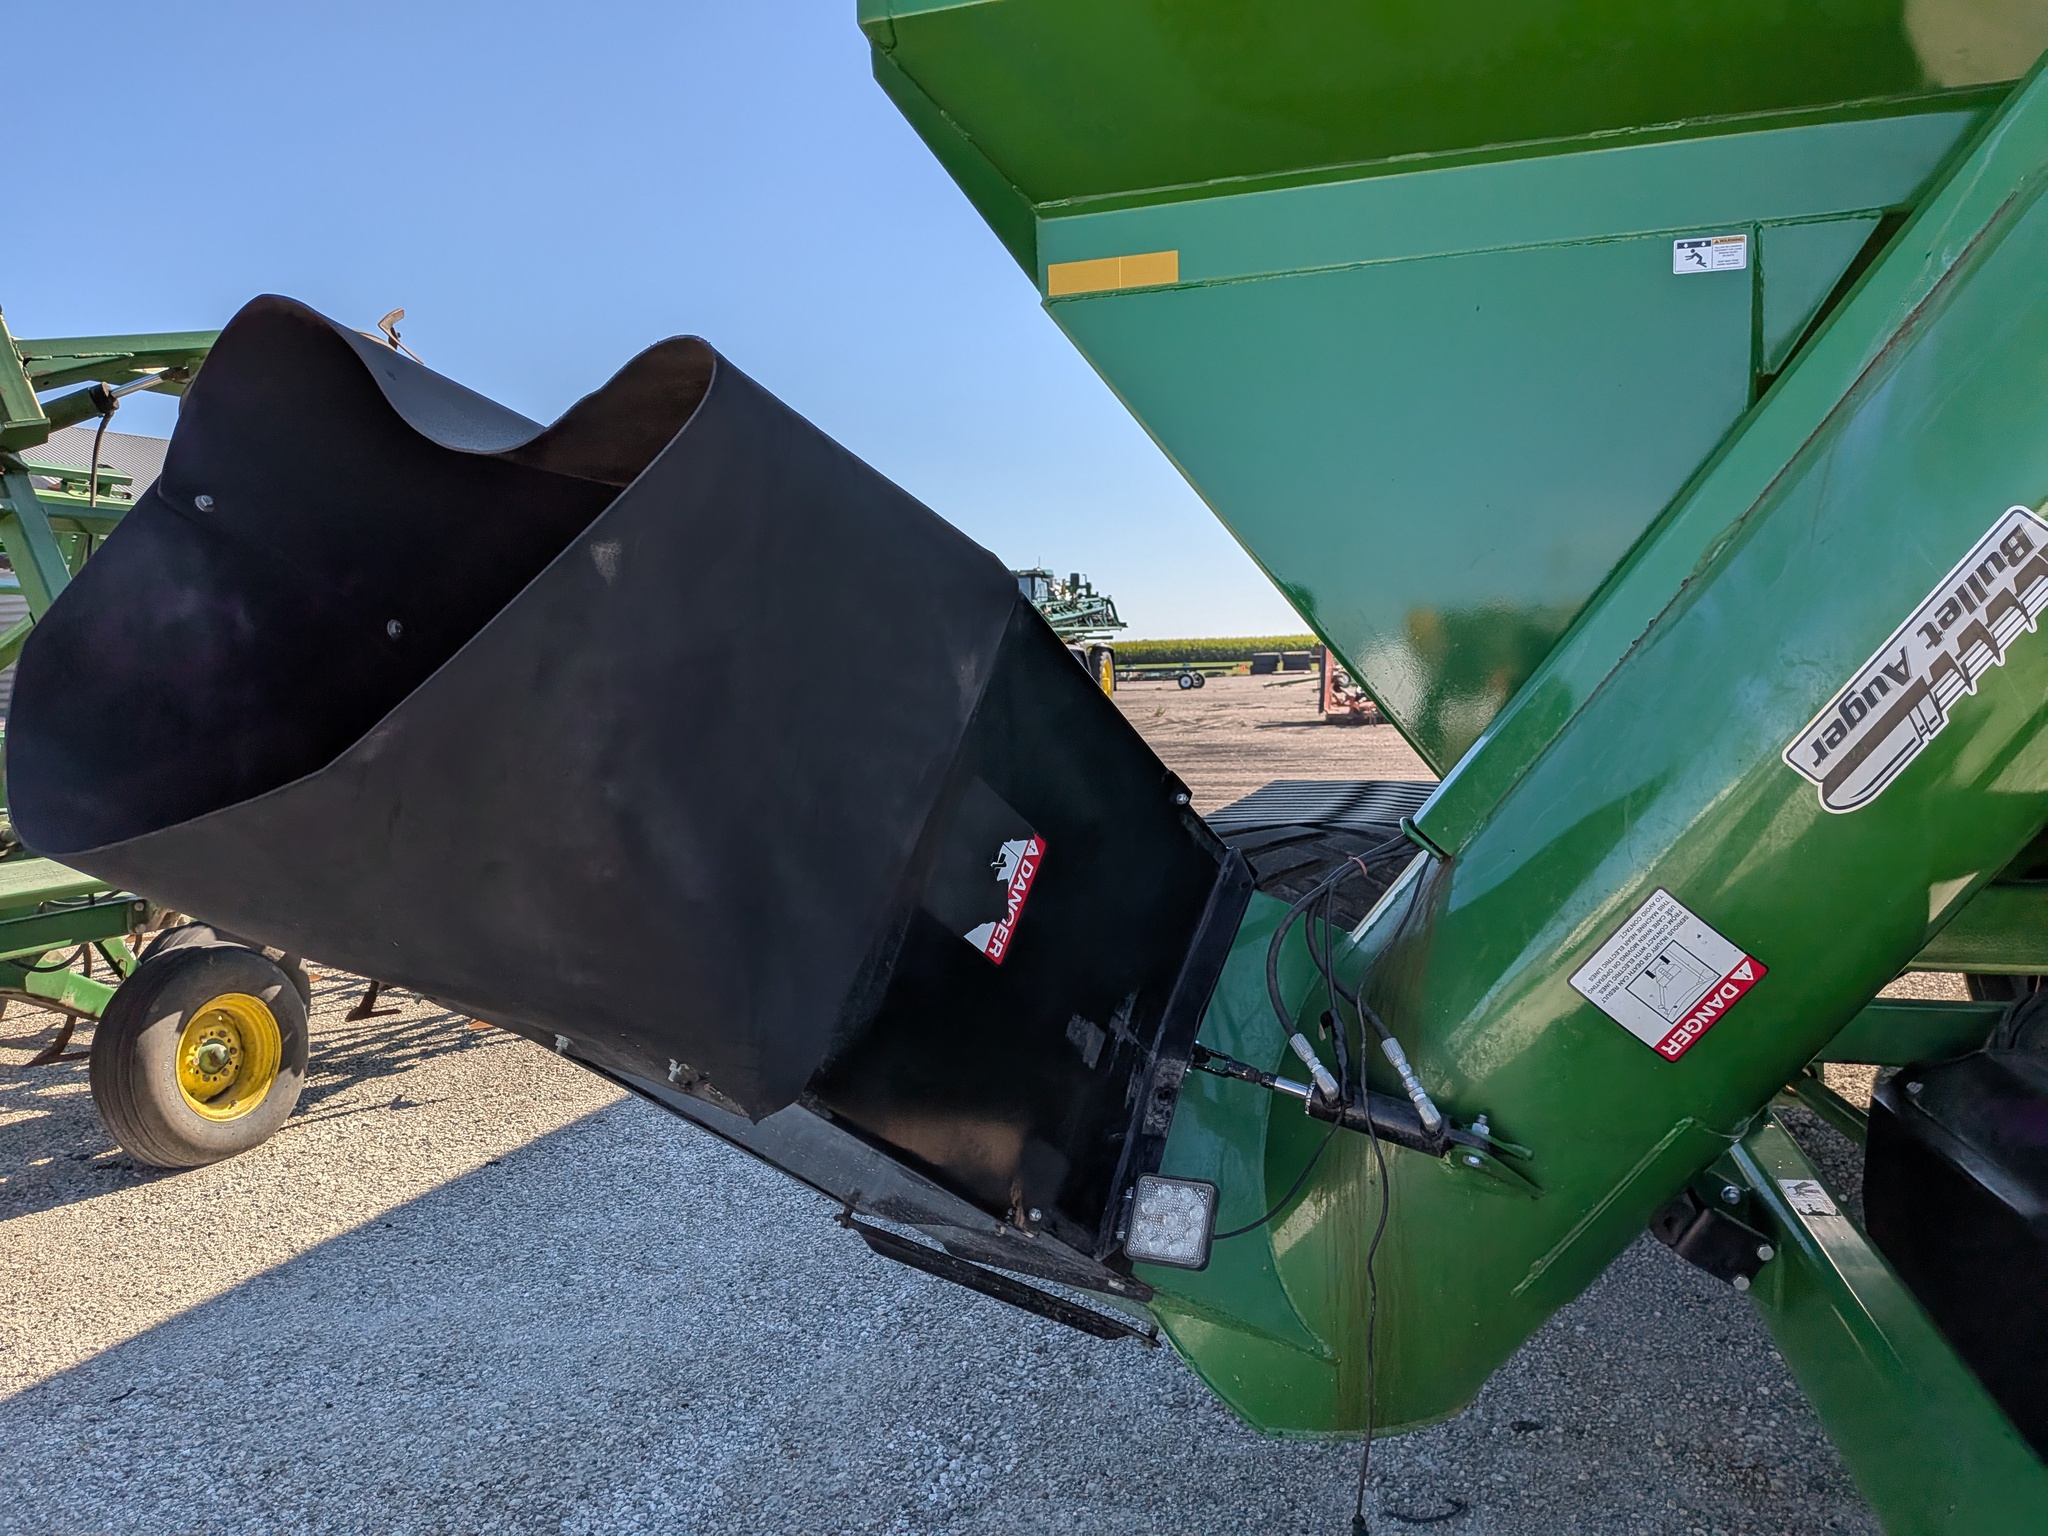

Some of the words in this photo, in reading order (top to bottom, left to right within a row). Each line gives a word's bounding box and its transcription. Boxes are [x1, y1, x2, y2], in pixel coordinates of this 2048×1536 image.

[1917, 523, 2035, 650] Bullet
[1812, 646, 1912, 768] Auger
[1654, 894, 1663, 902] TO
[1656, 899, 1670, 911] THIS
[1639, 901, 1656, 917] AVOID
[1664, 904, 1676, 915] USE
[1666, 909, 1683, 925] FROM
[1617, 915, 1642, 939] CONTACT.
[1635, 910, 1659, 933] MACHINE
[1651, 914, 1666, 929] CARE
[1666, 914, 1689, 936] SERIOUS
[1622, 932, 1638, 946] NEAR
[1637, 927, 1653, 943] WHEN
[1644, 923, 1669, 946] CONTACT
[1618, 941, 1639, 962] MOVING
[1632, 945, 1647, 959] WITH
[1649, 935, 1669, 953] INJURY
[1601, 945, 1625, 968] ELECTRIC
[1642, 951, 1652, 961] OR
[1611, 960, 1621, 969] OR
[1611, 957, 1635, 981] ELECTRIC
[1627, 959, 1644, 976] DEATH
[1586, 967, 1614, 994] OPERATING
[1587, 966, 1603, 981] LINES
[1616, 974, 1629, 986] CAN
[1596, 979, 1613, 995] LINES.
[1600, 984, 1619, 1003] RESULT
[1659, 981, 1740, 1057] DANGER
